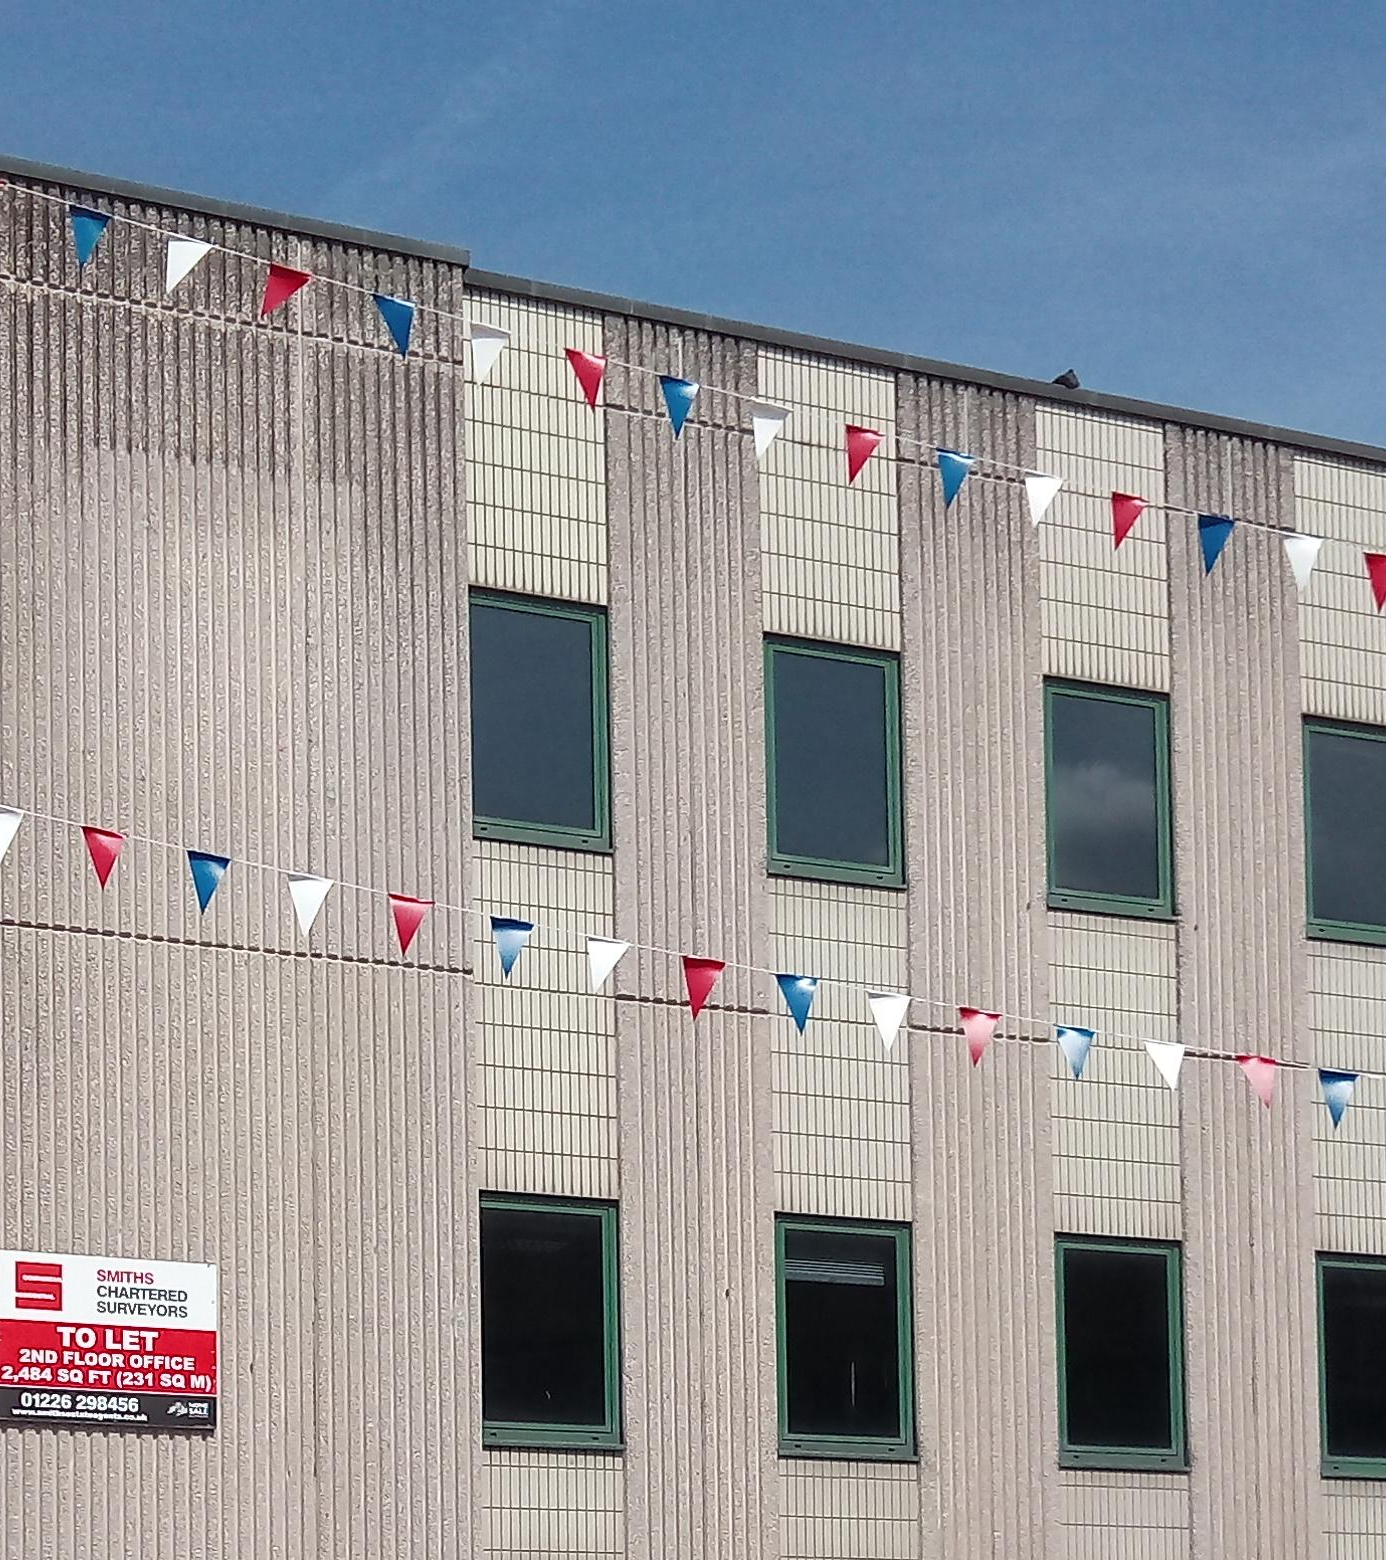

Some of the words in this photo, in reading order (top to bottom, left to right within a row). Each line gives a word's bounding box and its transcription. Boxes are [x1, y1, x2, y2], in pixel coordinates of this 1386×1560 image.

[97, 1269, 154, 1285] SMITHS
[97, 1286, 188, 1302] CHARTERED
[97, 1301, 188, 1318] SURVEYORS
[57, 1326, 96, 1348] TO
[105, 1329, 159, 1352] LET
[19, 1348, 58, 1364] 2ND
[63, 1351, 125, 1368] FLOOR
[129, 1354, 195, 1371] OFFICE
[0, 1365, 53, 1383] 2,484
[58, 1368, 85, 1384] SQ
[89, 1370, 112, 1385] FT
[116, 1371, 154, 1389] (231
[160, 1373, 186, 1389] SQ
[190, 1375, 213, 1392] M)
[20, 1391, 72, 1410] 01226
[76, 1394, 139, 1413] 298456
